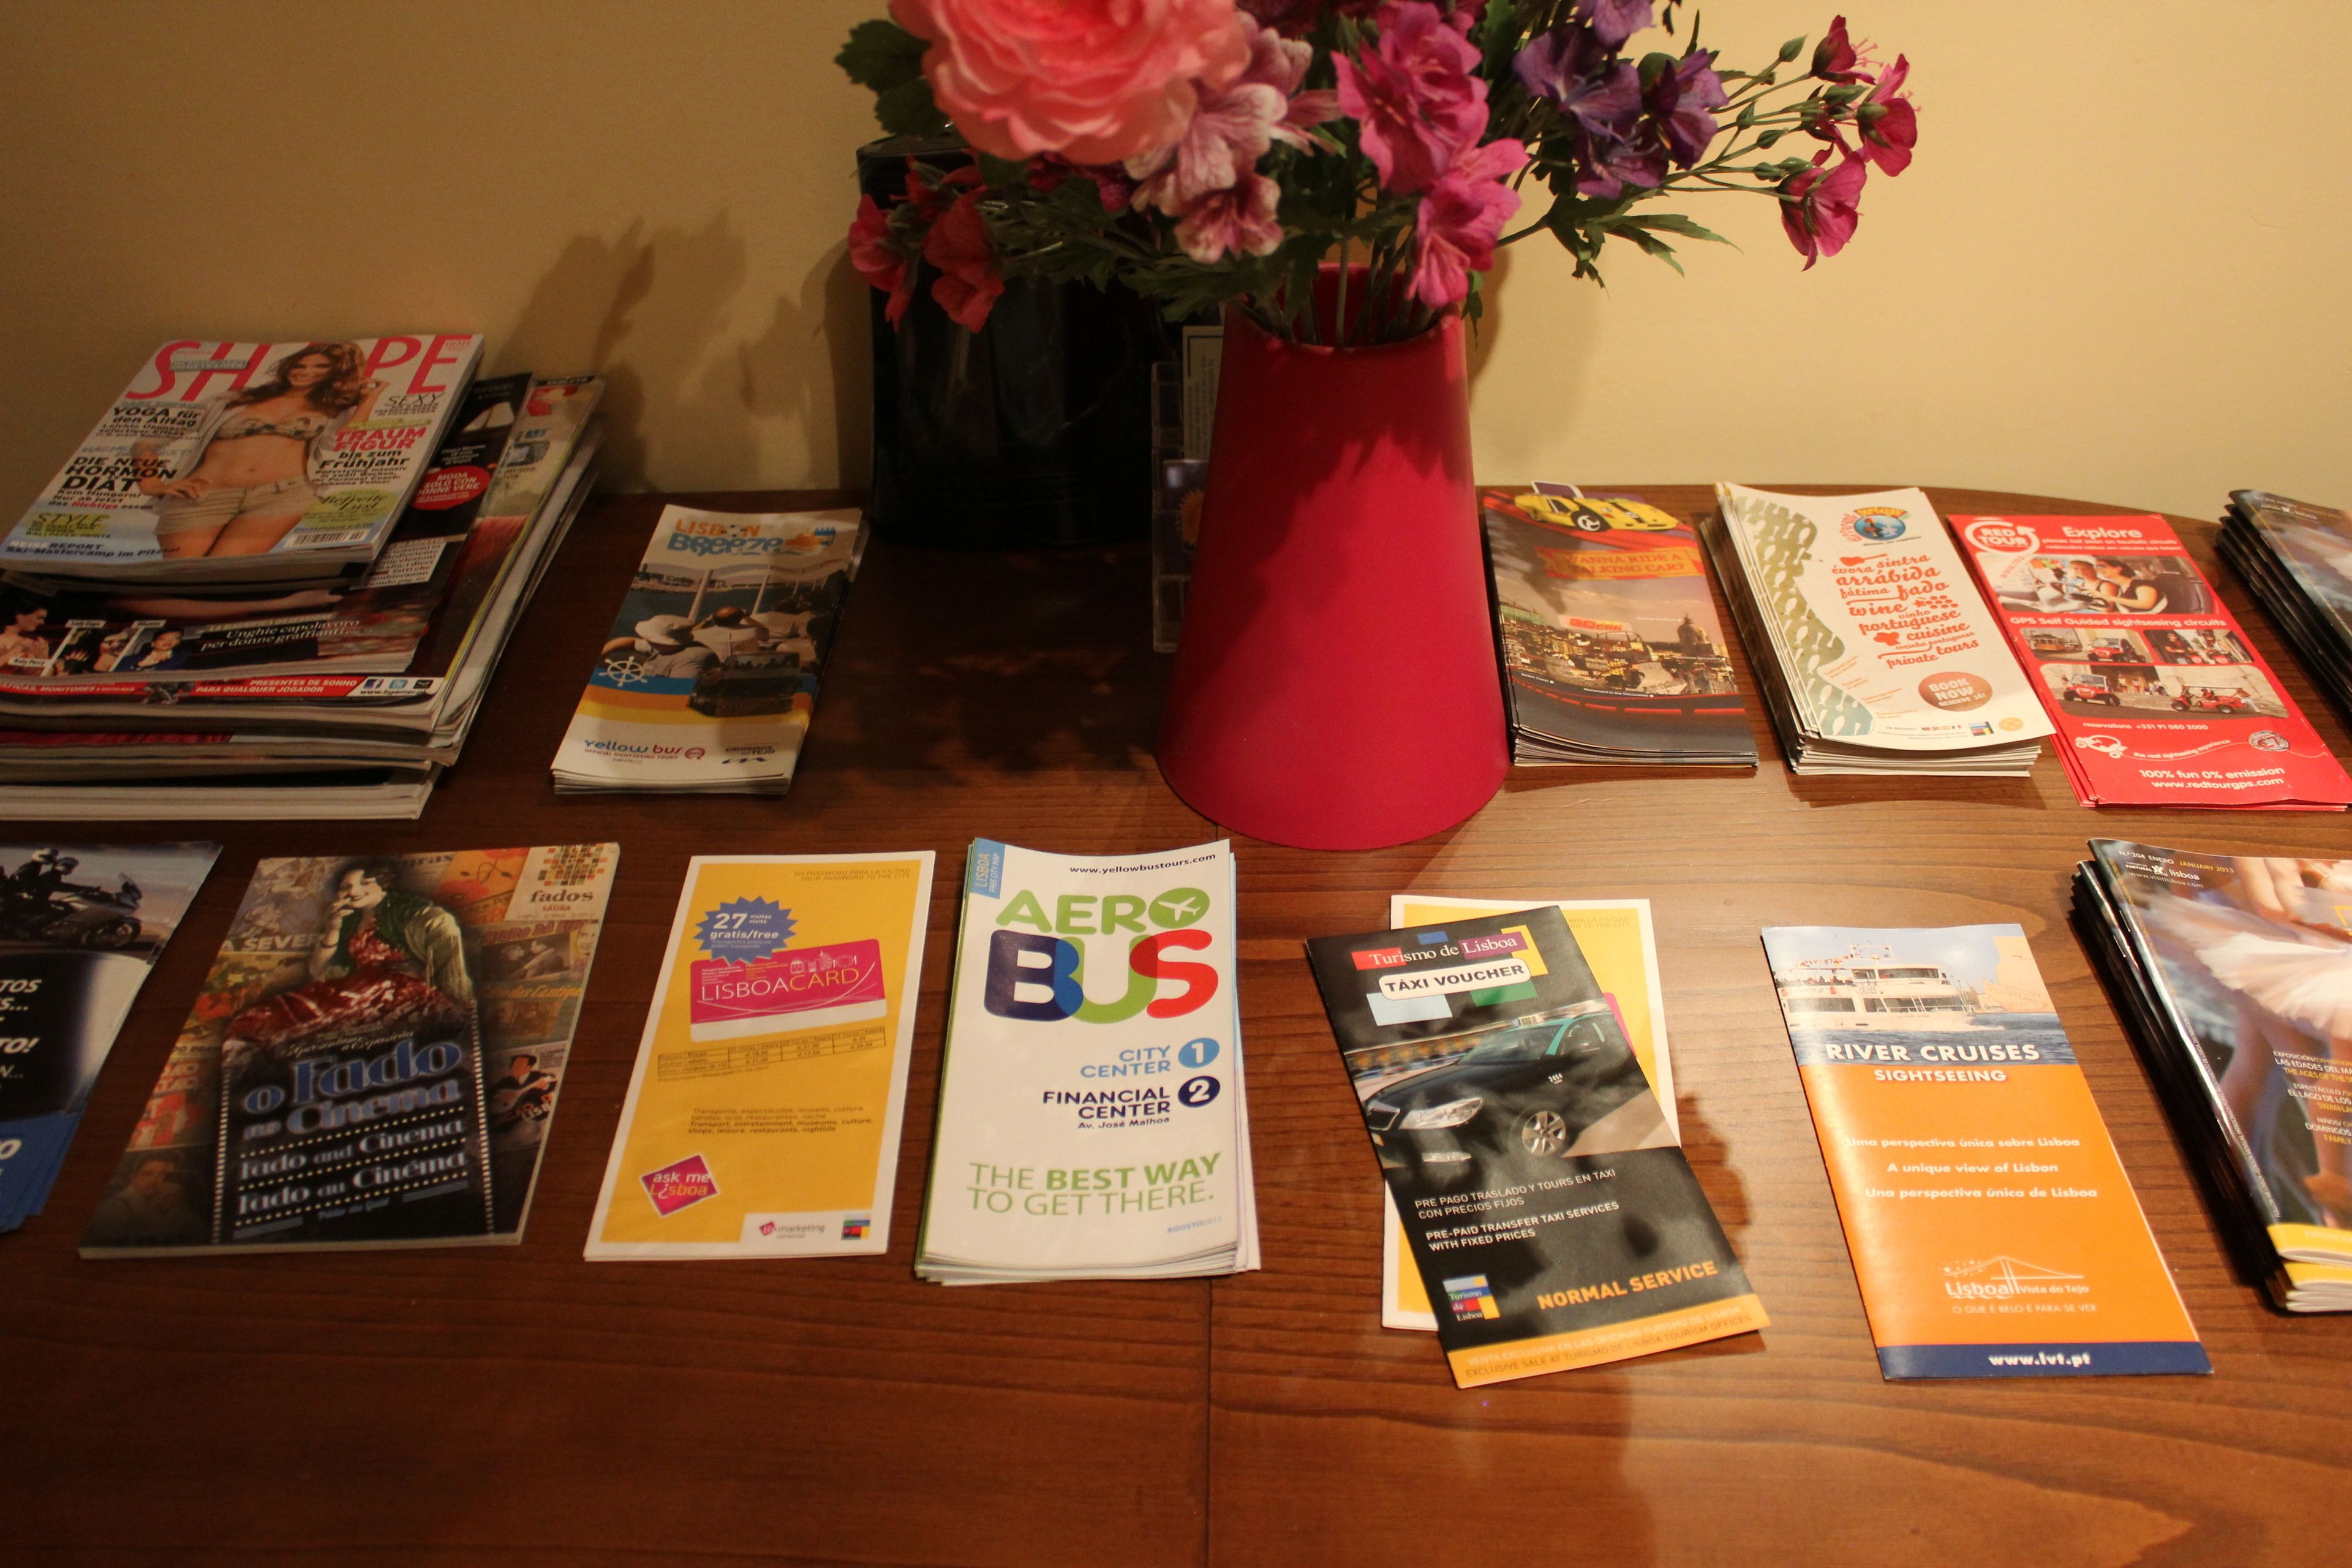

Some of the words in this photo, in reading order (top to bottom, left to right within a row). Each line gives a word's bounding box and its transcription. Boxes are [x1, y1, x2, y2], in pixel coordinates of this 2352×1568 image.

[126, 334, 472, 401] SHPE
[385, 393, 445, 407] SEXY
[114, 407, 170, 417] YOGA
[176, 410, 202, 419] für
[146, 417, 197, 427] Alltag
[334, 426, 427, 442] TRAUM
[333, 439, 415, 452] FIGUR
[74, 456, 108, 466] DIE
[114, 458, 172, 467] NEUE
[319, 457, 410, 469] Frühjahr
[339, 451, 360, 460] bis
[65, 466, 178, 478] HORMON
[61, 475, 142, 492] DIÄT
[37, 513, 110, 527] STYLE
[1980, 528, 2016, 537] RED
[2061, 526, 2143, 540] Explore
[1977, 536, 2029, 546] TOUR
[1832, 565, 1875, 575] évora
[1877, 555, 1931, 569] sintra
[1896, 580, 1950, 601] fado
[1848, 603, 1908, 616] wine
[1899, 610, 1932, 619] vinho
[1859, 611, 1961, 635] portuguese
[2064, 617, 2110, 625] Guided
[2111, 618, 2182, 628] sightseeing
[2184, 617, 2227, 626] circuits
[227, 626, 277, 639] Unghie
[1907, 622, 1970, 641] cuisine
[228, 636, 276, 647] donne
[1887, 654, 1939, 669] private
[1936, 639, 1980, 656] tours
[1928, 678, 1970, 692] BOOK
[1934, 686, 1974, 701] NOW
[652, 744, 684, 754] bus
[2138, 769, 2175, 778] 100%
[2176, 769, 2200, 778] fun
[2202, 771, 2223, 779] 0%
[2225, 766, 2285, 779] emission
[2151, 777, 2285, 790] www.redtourgps.com
[974, 852, 990, 888] LISBOA
[1069, 853, 1216, 875] www.yellowbustours.com
[2147, 854, 2174, 865] ENERO
[2179, 861, 2215, 871] JANUARY
[2128, 871, 2204, 889] www.visitlisboa.com
[2168, 869, 2201, 881] lisboa
[530, 889, 594, 903] fados
[713, 913, 748, 930] 27
[710, 930, 779, 940] gratis/free
[1368, 949, 1437, 967] Turismo
[1440, 943, 1460, 957] de
[1462, 935, 1518, 955] Lisboa
[701, 968, 859, 1001] LISBOACARD
[983, 929, 1219, 1025] BUS
[1385, 978, 1430, 993] TÁXI
[1434, 964, 1526, 987] VOUCHER
[1118, 1044, 1171, 1063] CITY
[1825, 1043, 1912, 1061] RIVER
[1920, 1044, 2041, 1061] CRUISES
[293, 1039, 462, 1106] Fado
[1080, 1059, 1171, 1078] CENTER
[2274, 1058, 2291, 1066] LAS
[2291, 1060, 2324, 1071] EDADES
[2324, 1065, 2340, 1074] DEL
[1874, 1069, 2007, 1082] SIGHTSEEING
[1042, 1086, 1170, 1105] FINANCIAL
[2298, 1091, 2322, 1101] LAGO
[2335, 1096, 2352, 1105] LOS
[285, 1079, 464, 1135] Cinema
[1078, 1100, 1171, 1120] CENTER
[1098, 1120, 1125, 1129] José
[1128, 1117, 1170, 1127] Malhoa
[2304, 1122, 2352, 1137] DOMINGOS
[239, 1152, 309, 1181] Fado
[313, 1143, 355, 1165] and
[358, 1118, 466, 1153] Cinema
[1847, 1138, 1878, 1147] Uma
[1881, 1138, 1956, 1149] perspectiva
[1959, 1137, 1995, 1147] única
[1998, 1138, 2034, 1147] sobre
[2037, 1137, 2080, 1147] Lisboa
[652, 1171, 681, 1183] ask
[685, 1173, 710, 1183] me
[968, 1163, 1035, 1190] THE
[1046, 1167, 1136, 1192] BEST
[1142, 1152, 1222, 1187] WAY
[1887, 1163, 1899, 1172] A
[1902, 1164, 1951, 1175] unique
[1955, 1164, 1990, 1173] view
[1994, 1163, 2010, 1173] of
[2013, 1163, 2059, 1172] Lisbon
[1414, 1198, 1438, 1209] PRE
[1439, 1194, 1469, 1207] PAGO
[1470, 1185, 1528, 1202] TRASLADO
[1537, 1177, 1574, 1191] TOURS
[1575, 1174, 1592, 1185] EN
[1593, 1169, 1616, 1180] TAXI
[1865, 1188, 1895, 1197] Una
[1899, 1188, 1982, 1200] perspectiva
[1986, 1188, 2025, 1198] única
[2029, 1188, 2048, 1197] de
[2051, 1188, 2098, 1197] Lisboa
[238, 1185, 311, 1215] Fado
[317, 1181, 347, 1198] au
[967, 1187, 1014, 1214] TO
[1023, 1193, 1091, 1216] GET
[1098, 1180, 1215, 1215] THERE.
[1419, 1209, 1443, 1220] CON
[1445, 1202, 1493, 1217] PRECIOS
[1494, 1197, 1525, 1210] FIJOS
[1425, 1225, 1479, 1242] PRE-PAID
[1481, 1216, 1539, 1232] TRANSFER
[1540, 1212, 1566, 1224] TAXI
[1566, 1201, 1620, 1218] SERVICES
[1428, 1240, 1459, 1252] WITH
[1461, 1235, 1494, 1248] FIXED
[1495, 1228, 1536, 1243] PRICES
[1536, 1281, 1629, 1310] NORMAL
[1629, 1261, 1719, 1292] SERVICE
[1449, 1290, 1483, 1302] Turismo
[2035, 1304, 2060, 1313] PARA
[1465, 1360, 1521, 1378] EXCLUSIVE
[1521, 1355, 1548, 1368] SALE
[1550, 1354, 1563, 1363] AT
[1564, 1346, 1610, 1361] TURISMO
[1627, 1335, 1663, 1350] LISBOA
[1664, 1325, 1709, 1342] TOURISM
[1710, 1314, 1753, 1330] OFFICES
[1988, 1351, 2091, 1368] www.lvt.pt
